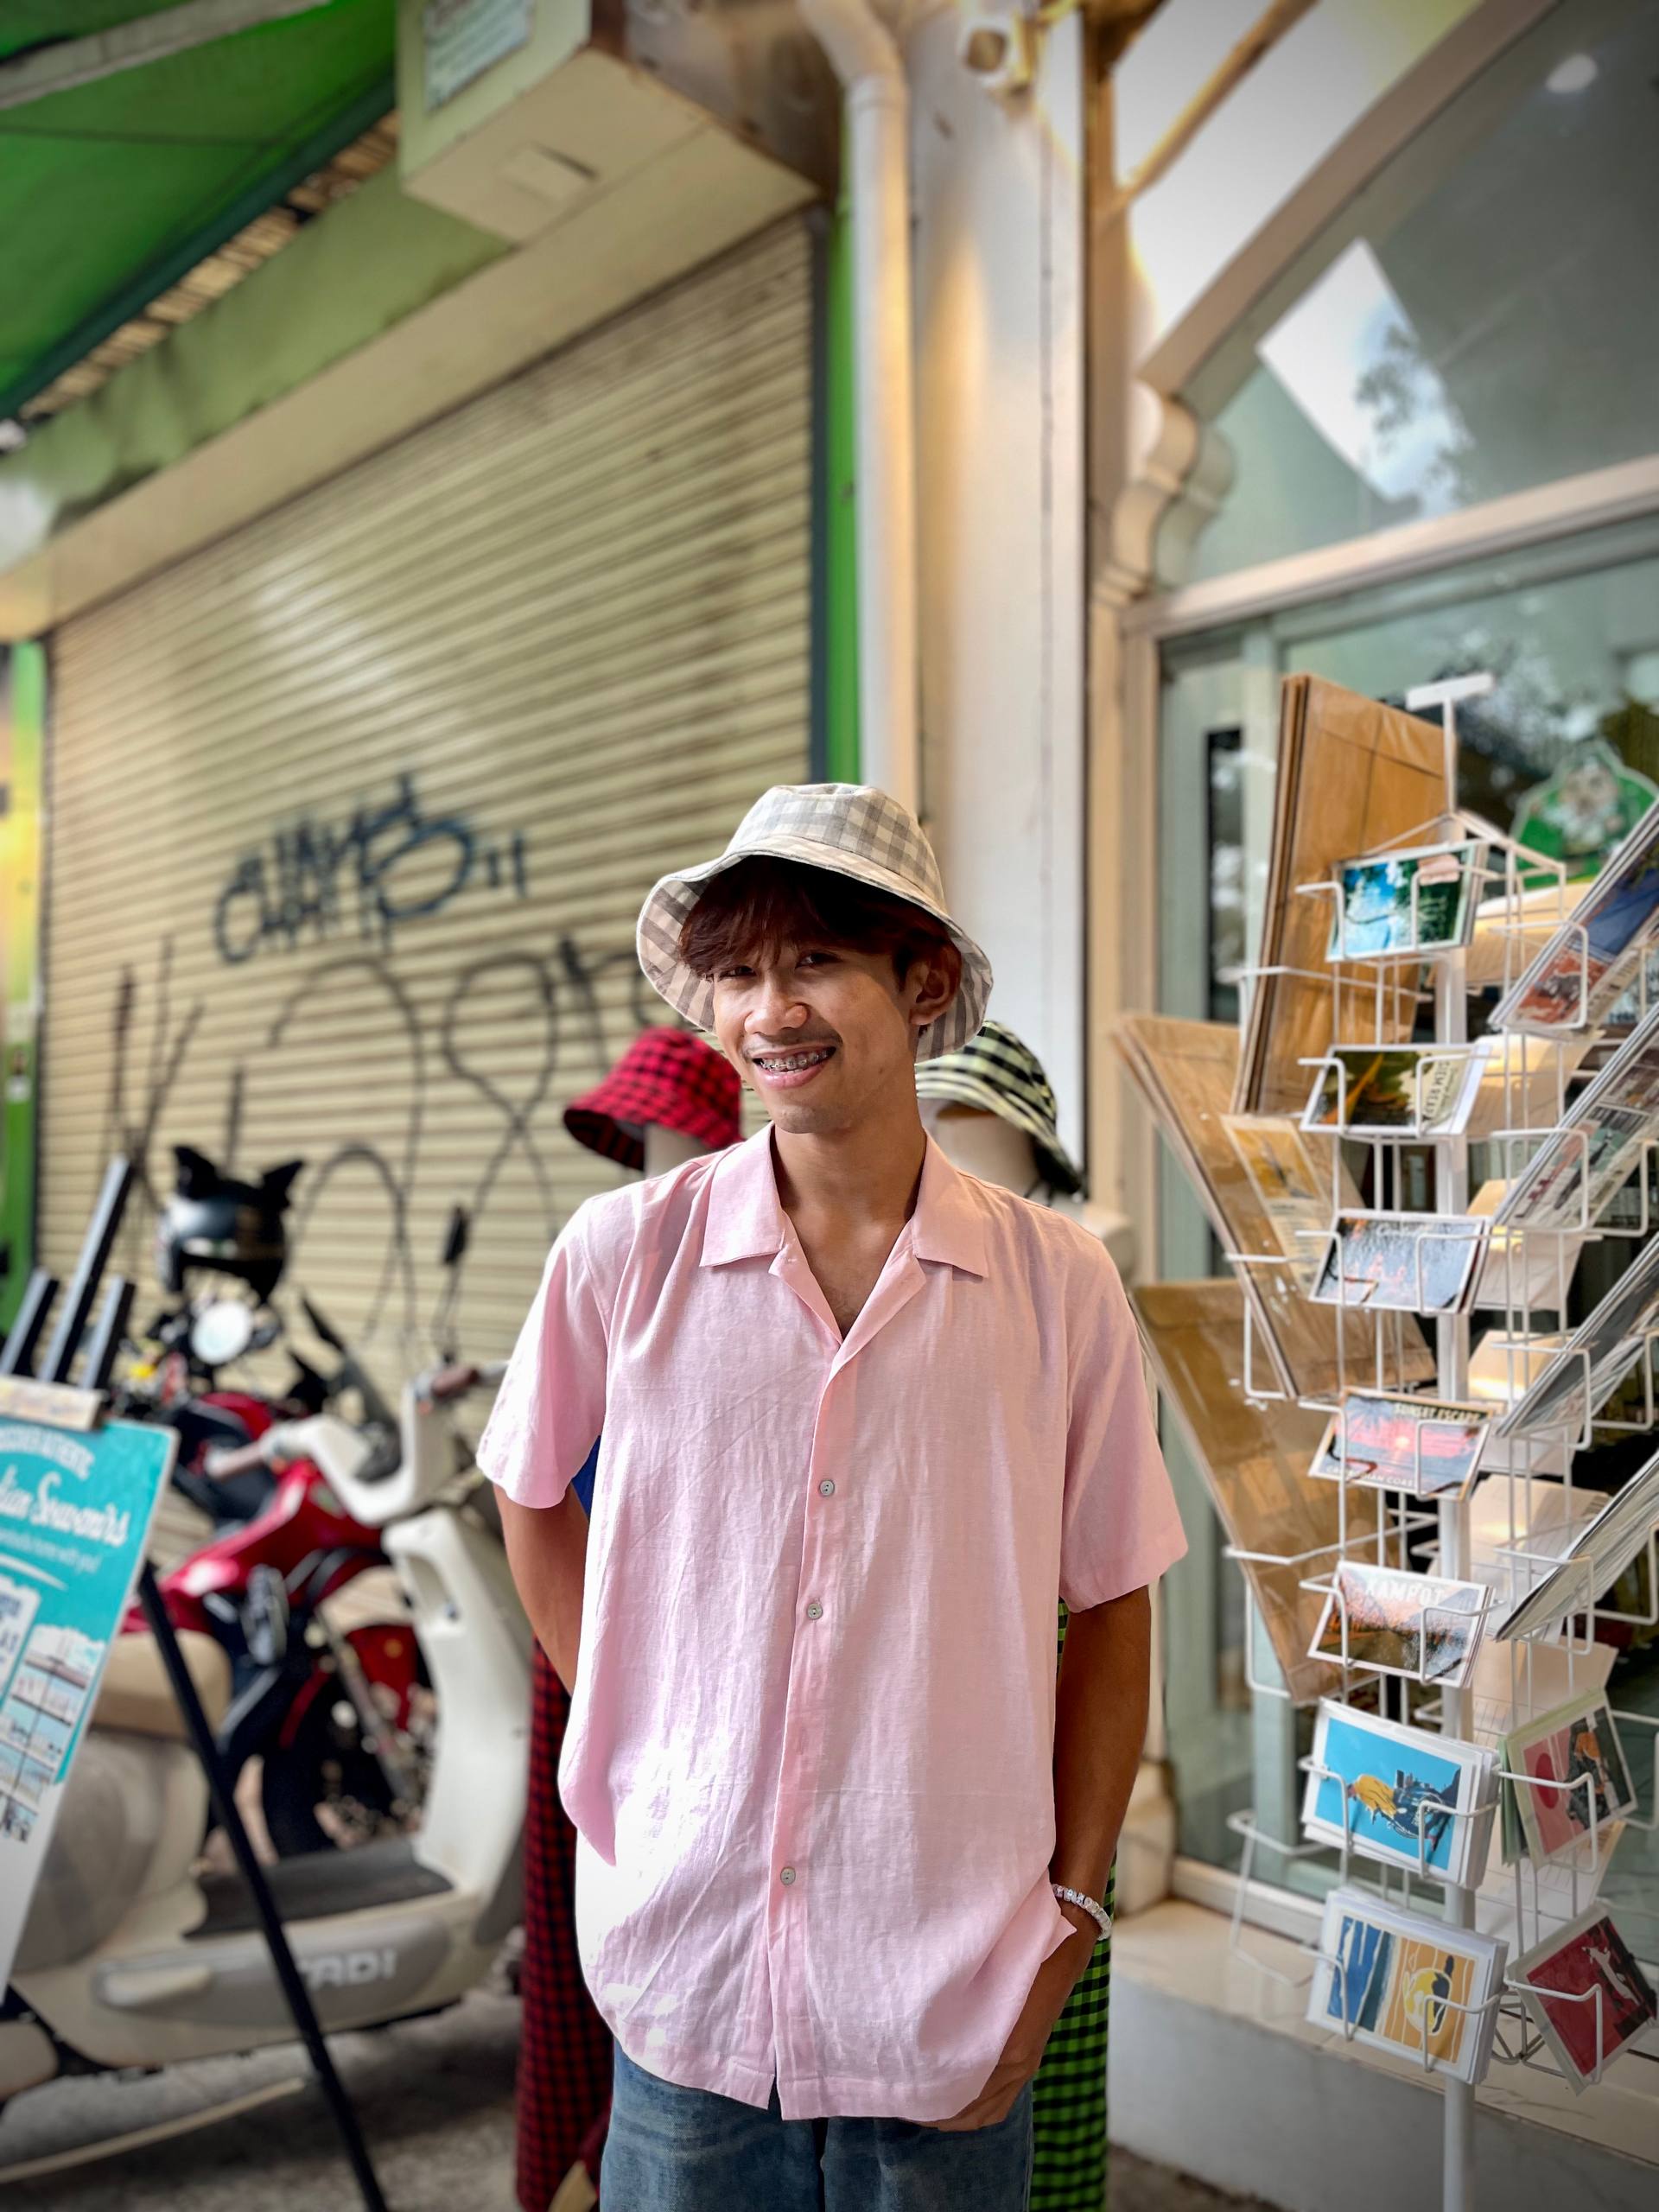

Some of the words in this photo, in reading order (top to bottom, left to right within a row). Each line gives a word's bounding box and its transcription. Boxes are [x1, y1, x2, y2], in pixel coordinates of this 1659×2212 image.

[1394, 1402, 1435, 1418] SUNSET
[1388, 1476, 1418, 1487] COAS
[1367, 1578, 1444, 1606] KAMPOT
